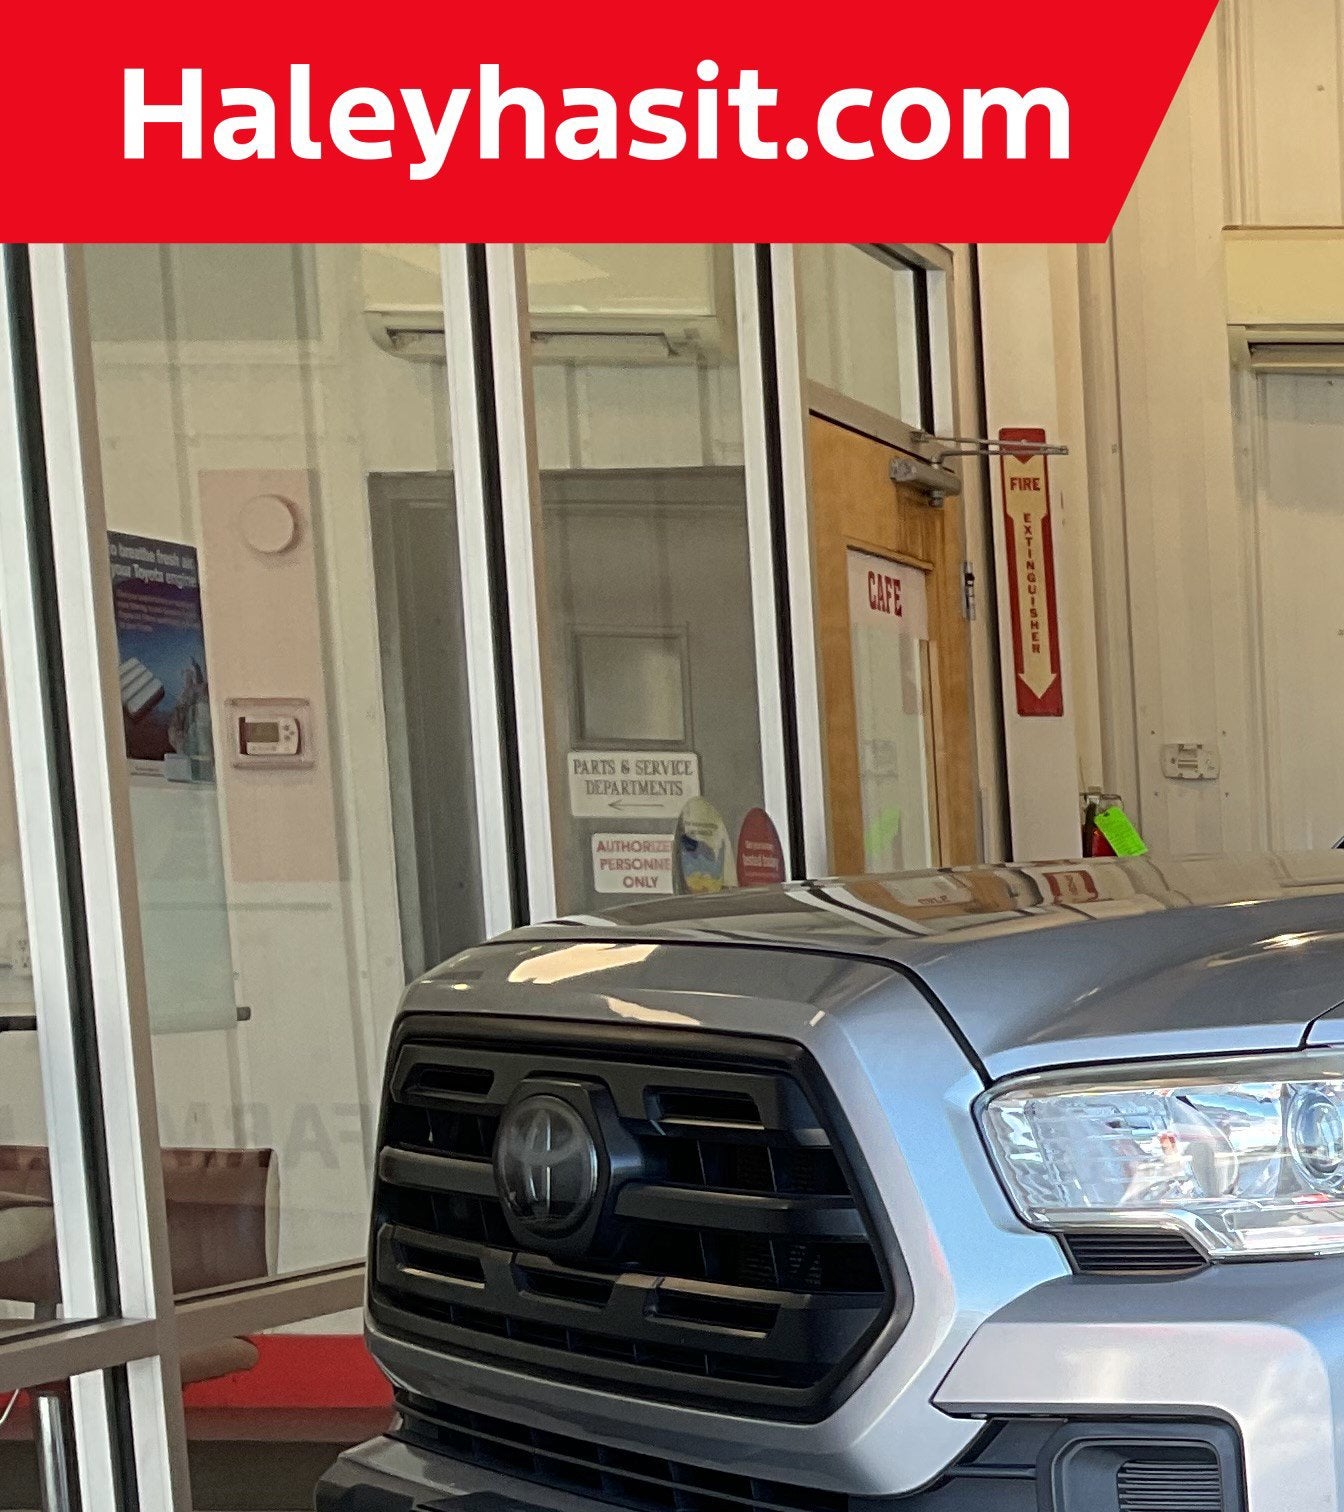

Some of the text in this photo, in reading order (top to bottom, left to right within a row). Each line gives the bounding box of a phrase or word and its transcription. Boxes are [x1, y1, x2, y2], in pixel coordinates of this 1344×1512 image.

[1010, 476, 1041, 492] FIRE
[1022, 512, 1041, 654] EXTINGUISHER
[867, 570, 903, 618] CAFE
[573, 759, 694, 776] PARTS & SERVICE
[585, 779, 684, 796] DEPARTMENTS
[596, 840, 673, 854] AUTHORIZE
[600, 858, 672, 871] PERSONNE
[622, 876, 659, 889] ONLY
